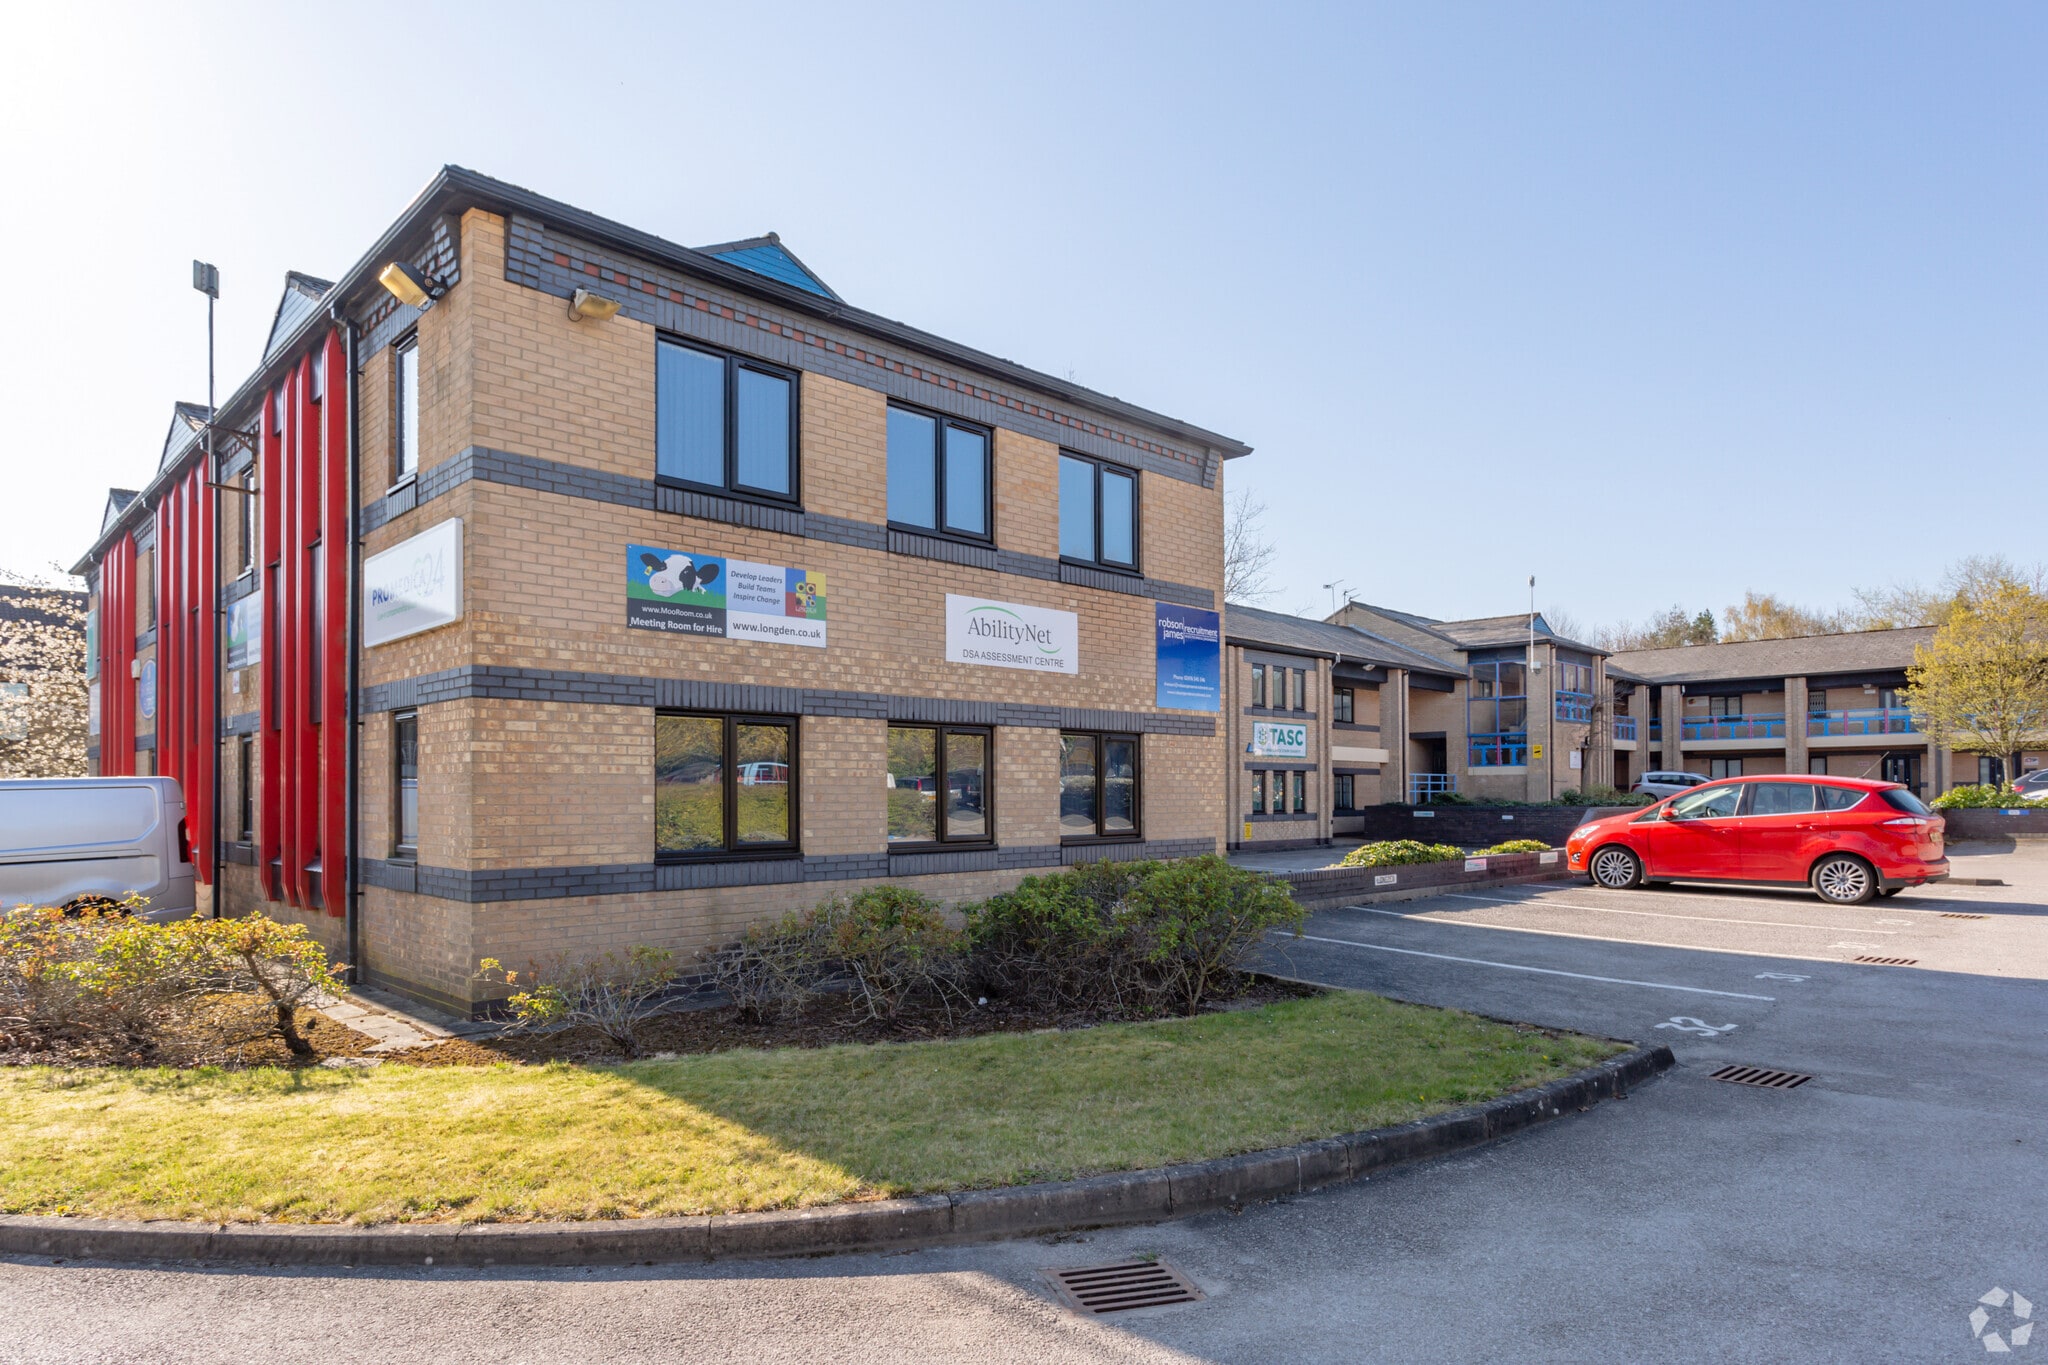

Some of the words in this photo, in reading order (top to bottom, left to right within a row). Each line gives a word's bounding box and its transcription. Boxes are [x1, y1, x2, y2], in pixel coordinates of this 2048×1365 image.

[730, 570, 757, 581] Develop
[758, 574, 783, 584] Leaders
[738, 582, 755, 590] Build
[756, 584, 776, 593] Teams
[733, 592, 755, 602] Inspire
[756, 595, 780, 605] Change
[641, 606, 713, 619] www.MooRoom.co.uk
[630, 616, 666, 630] Meeting
[667, 620, 692, 631] Room
[693, 622, 705, 632] for
[706, 624, 723, 634] Hire
[1158, 616, 1183, 630] robson
[732, 622, 821, 639] www.longden.co.uk
[967, 616, 1052, 645] AbilityNet
[1163, 627, 1183, 640] james
[1184, 625, 1218, 637] recruitment
[962, 648, 980, 659] DSA
[981, 651, 1033, 665] ASSESSMENT
[1034, 656, 1065, 668] CENTRE
[1269, 728, 1303, 746] TASC
